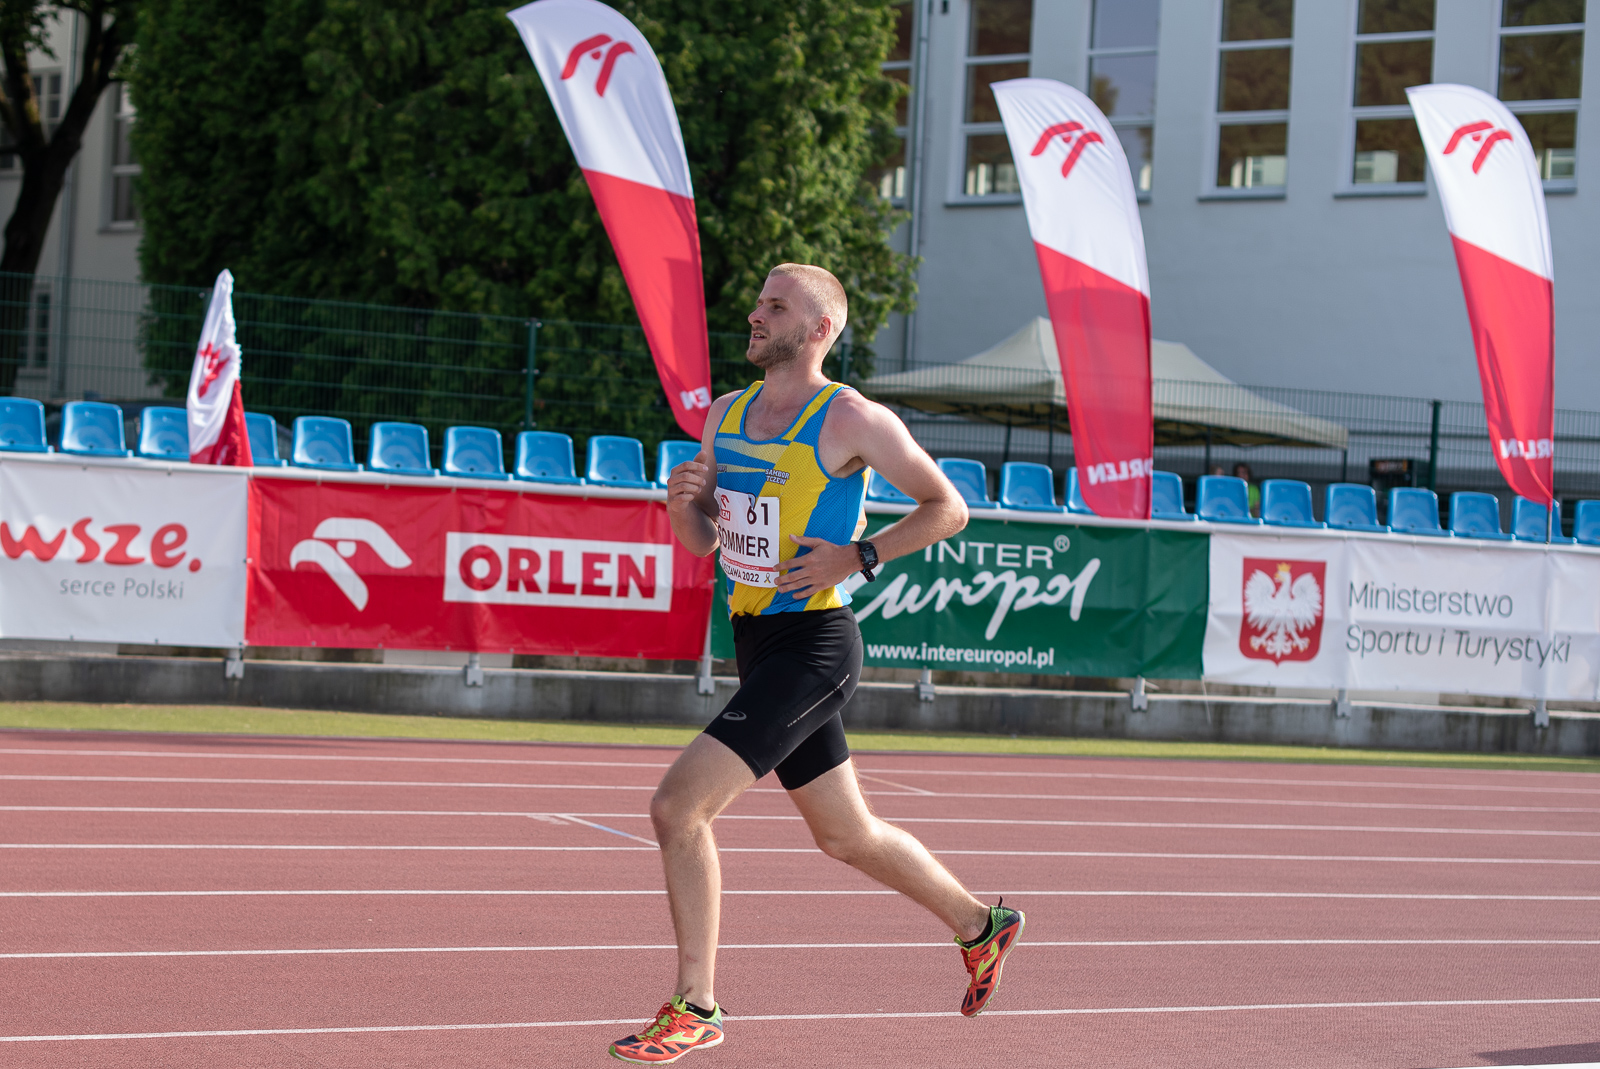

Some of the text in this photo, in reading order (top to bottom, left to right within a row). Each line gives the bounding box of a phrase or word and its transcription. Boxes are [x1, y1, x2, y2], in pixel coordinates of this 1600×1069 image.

[765, 468, 790, 480] SAMBOR
[766, 475, 788, 485] TCZEW
[459, 544, 656, 599] ORLEN
[742, 571, 760, 583] 2022
[60, 577, 184, 600] serce Polski
[1348, 580, 1513, 618] Ministerstwo
[867, 642, 1055, 668] www.intereuropol.pl
[1346, 623, 1572, 668] Sportu i Turystyki
